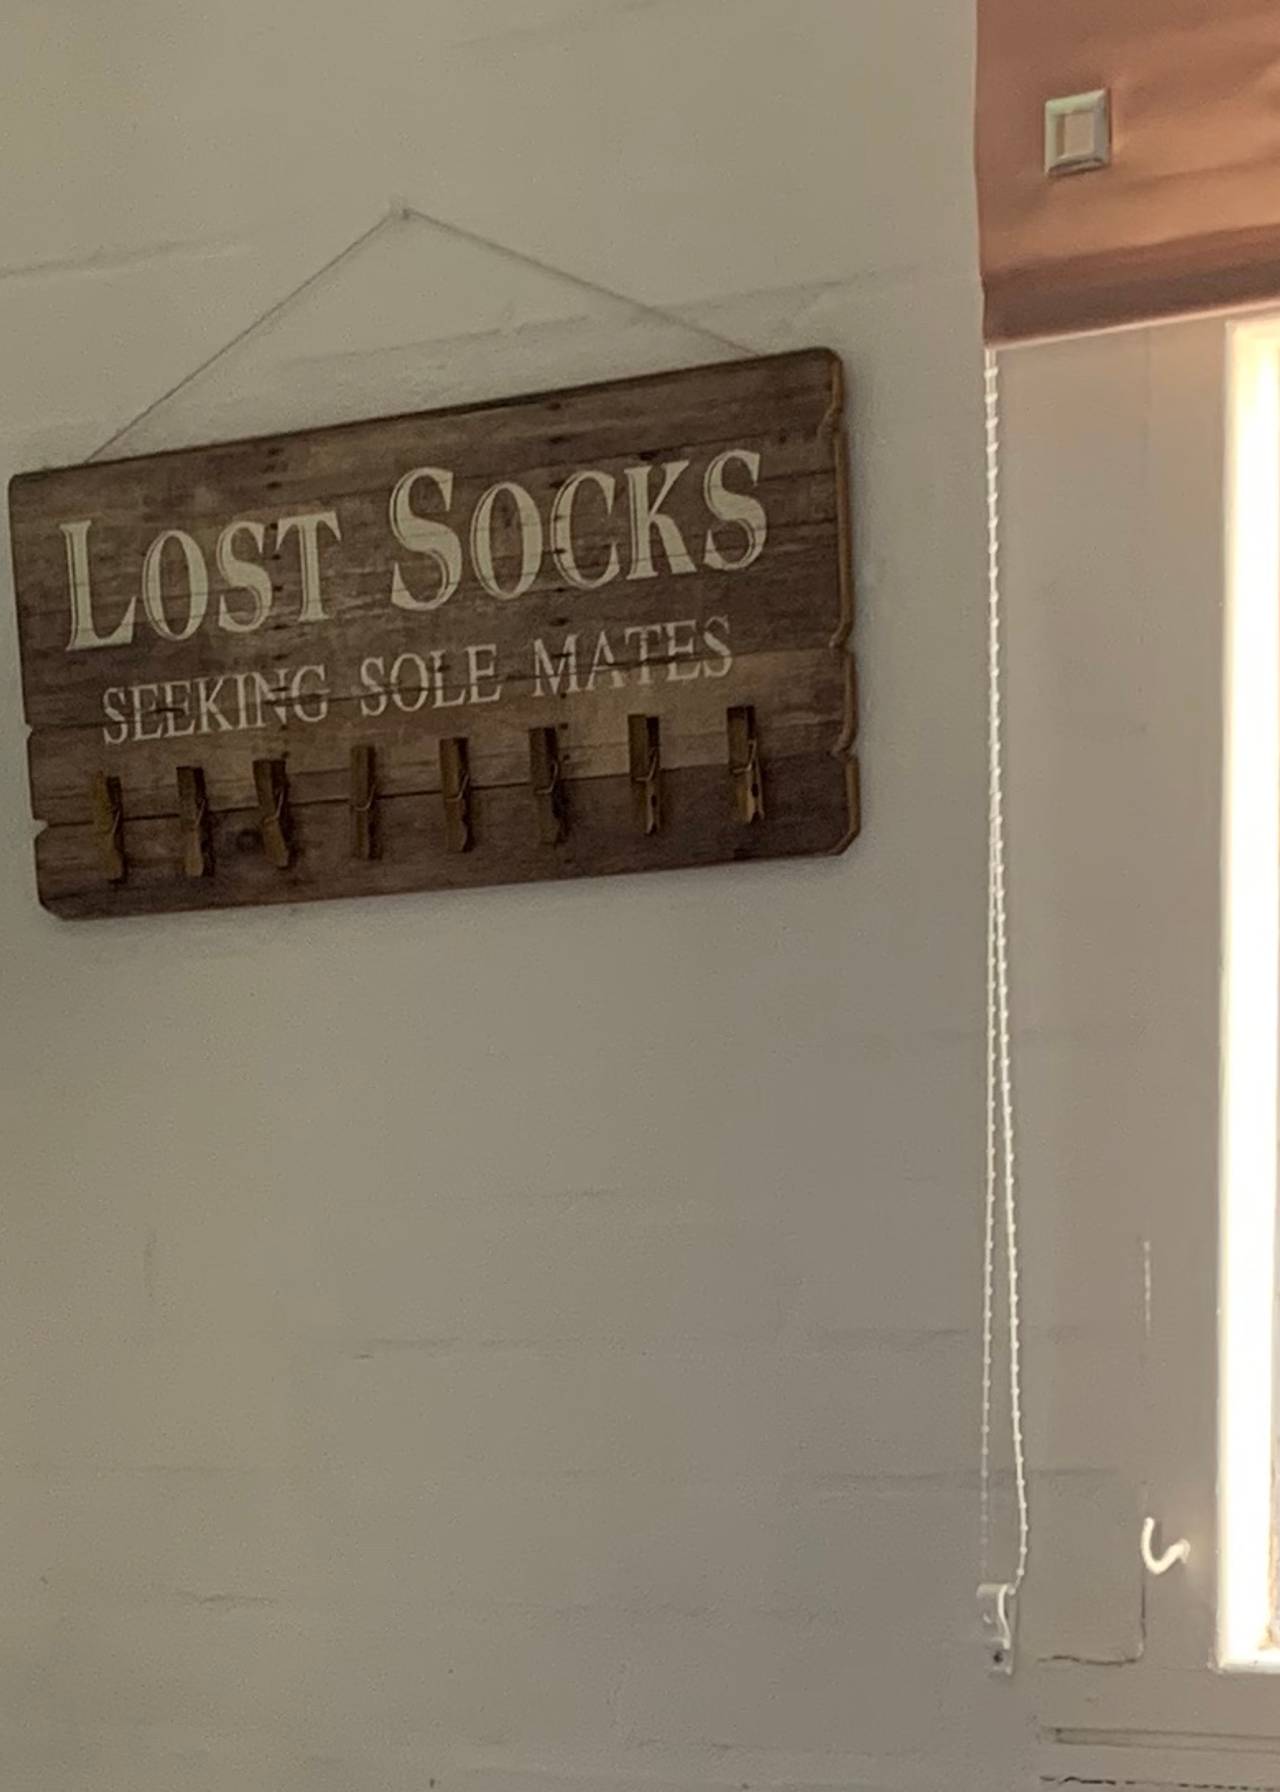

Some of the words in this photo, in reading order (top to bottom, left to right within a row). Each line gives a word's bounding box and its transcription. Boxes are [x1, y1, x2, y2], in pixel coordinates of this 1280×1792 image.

[59, 508, 342, 653] LOST
[389, 448, 769, 611] SOCKS
[101, 664, 329, 745] SEEKING
[359, 642, 504, 717] SOLE
[532, 614, 734, 698] MATES
